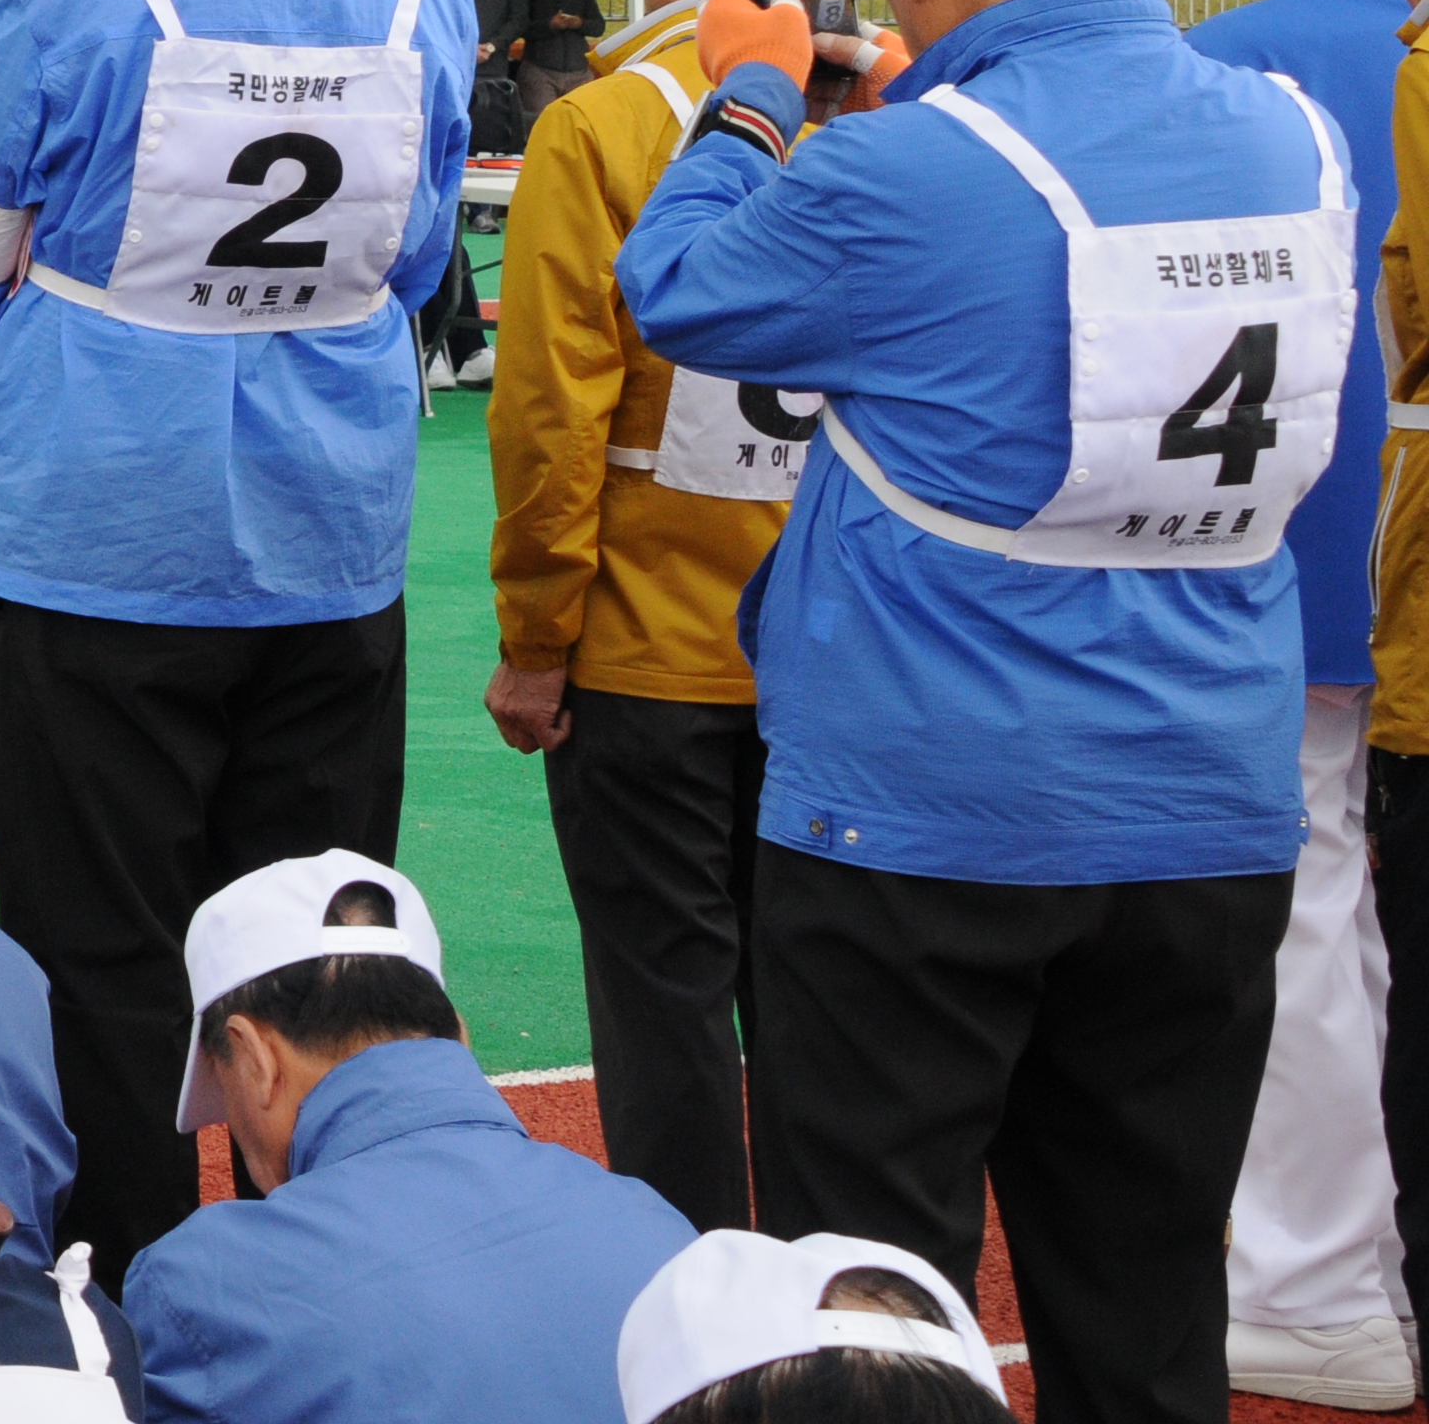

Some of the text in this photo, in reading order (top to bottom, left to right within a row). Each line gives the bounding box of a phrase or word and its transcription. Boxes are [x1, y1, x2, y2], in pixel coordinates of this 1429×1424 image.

[228, 72, 348, 104] 국민생활체육
[205, 132, 344, 268] 2
[1155, 247, 1294, 289] 국민생활체육
[187, 282, 318, 307] 게이트볼
[1156, 321, 1279, 487] 4
[1114, 506, 1258, 538] 게이트볼
